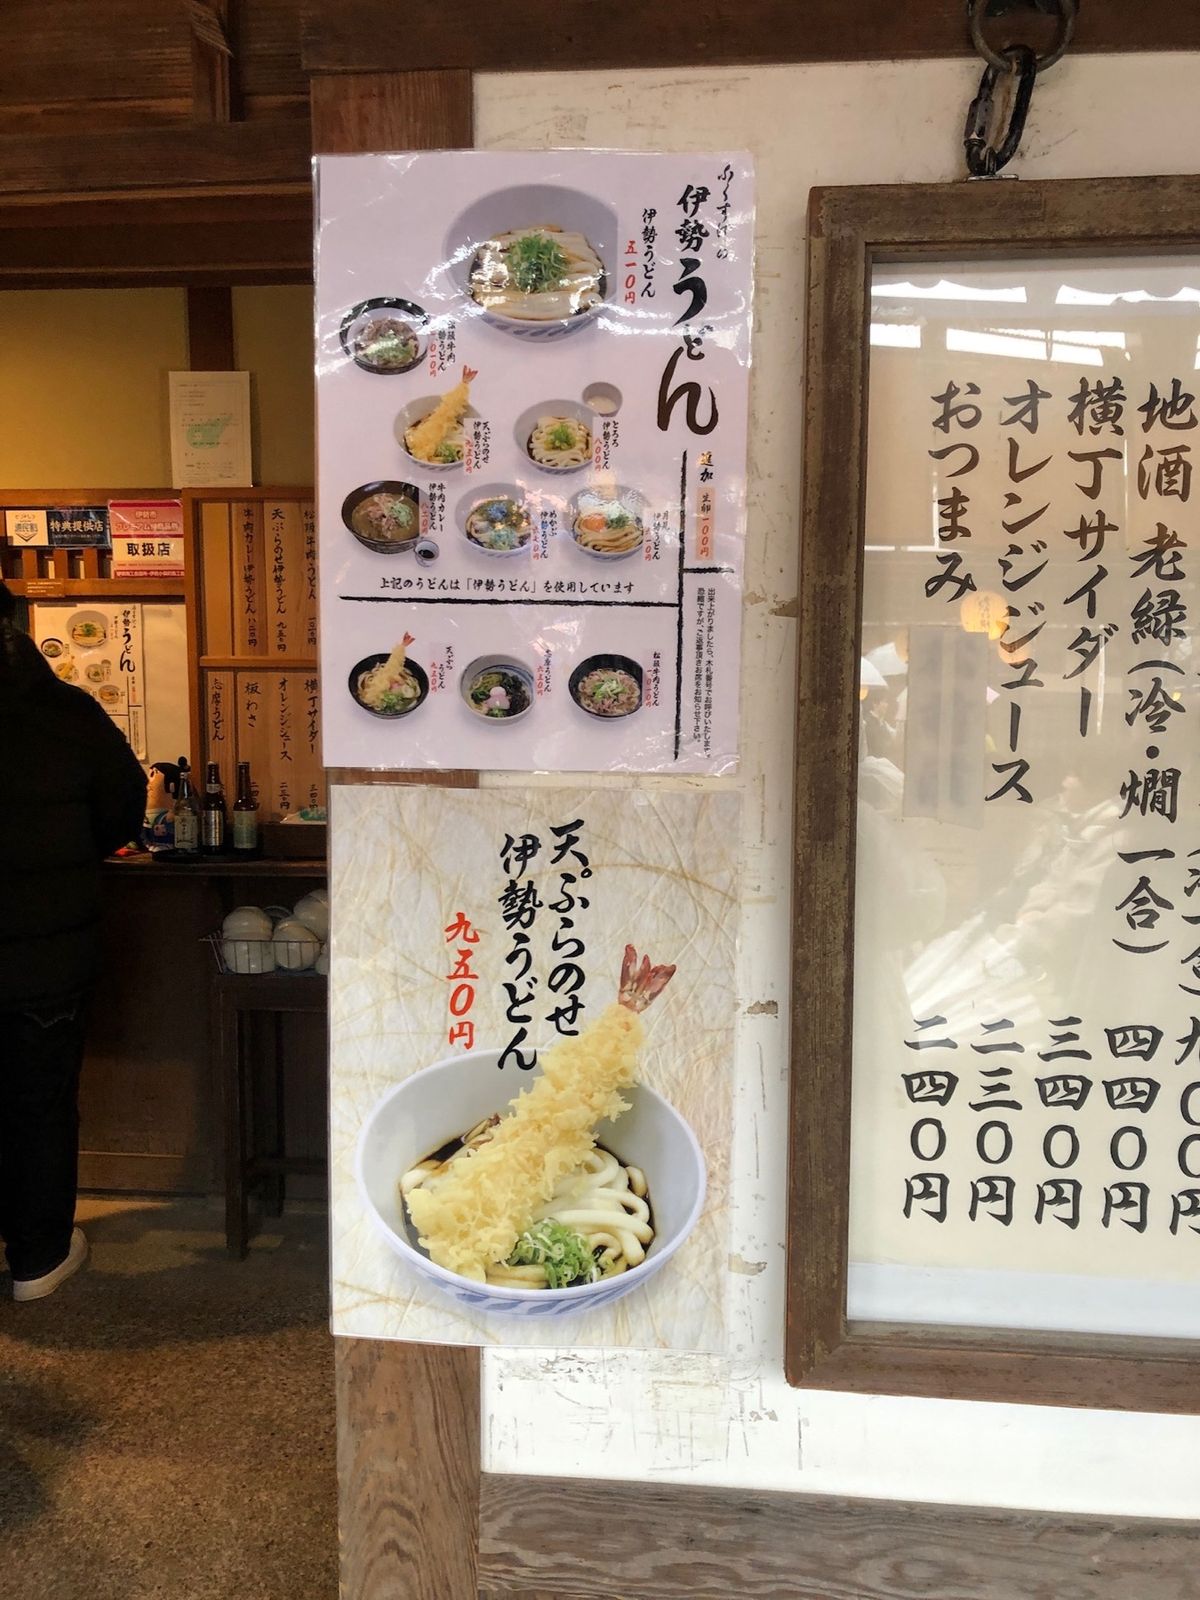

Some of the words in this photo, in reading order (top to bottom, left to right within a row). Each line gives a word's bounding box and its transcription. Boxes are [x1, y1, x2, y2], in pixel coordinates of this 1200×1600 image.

[640, 208, 658, 298] 伊勢うどん
[657, 184, 719, 435] 伊勢うどん
[473, 421, 482, 469] 伊勢うどん
[602, 421, 611, 469] 伊勢うどん
[611, 420, 620, 447] とろろ
[428, 482, 437, 531] 伊勢うどん
[437, 482, 446, 532] 牛肉カレー
[924, 379, 983, 604] おつまみ
[50, 520, 104, 533] 特典提供店
[127, 542, 171, 556] 取扱店
[1062, 376, 1128, 738] 横丁サイダー
[379, 577, 635, 594] 上記のうどんは「伊勢うどん」を使用しています
[984, 379, 1054, 805] オレンジジュース
[119, 609, 136, 673] 伊勢うどん
[244, 681, 262, 728] 板わさ
[278, 677, 293, 762] オレンジジュース
[304, 677, 319, 754] 横丁サイダー
[497, 833, 543, 1071] 伊勢うどん
[545, 818, 593, 1037] 天ぷらのせ
